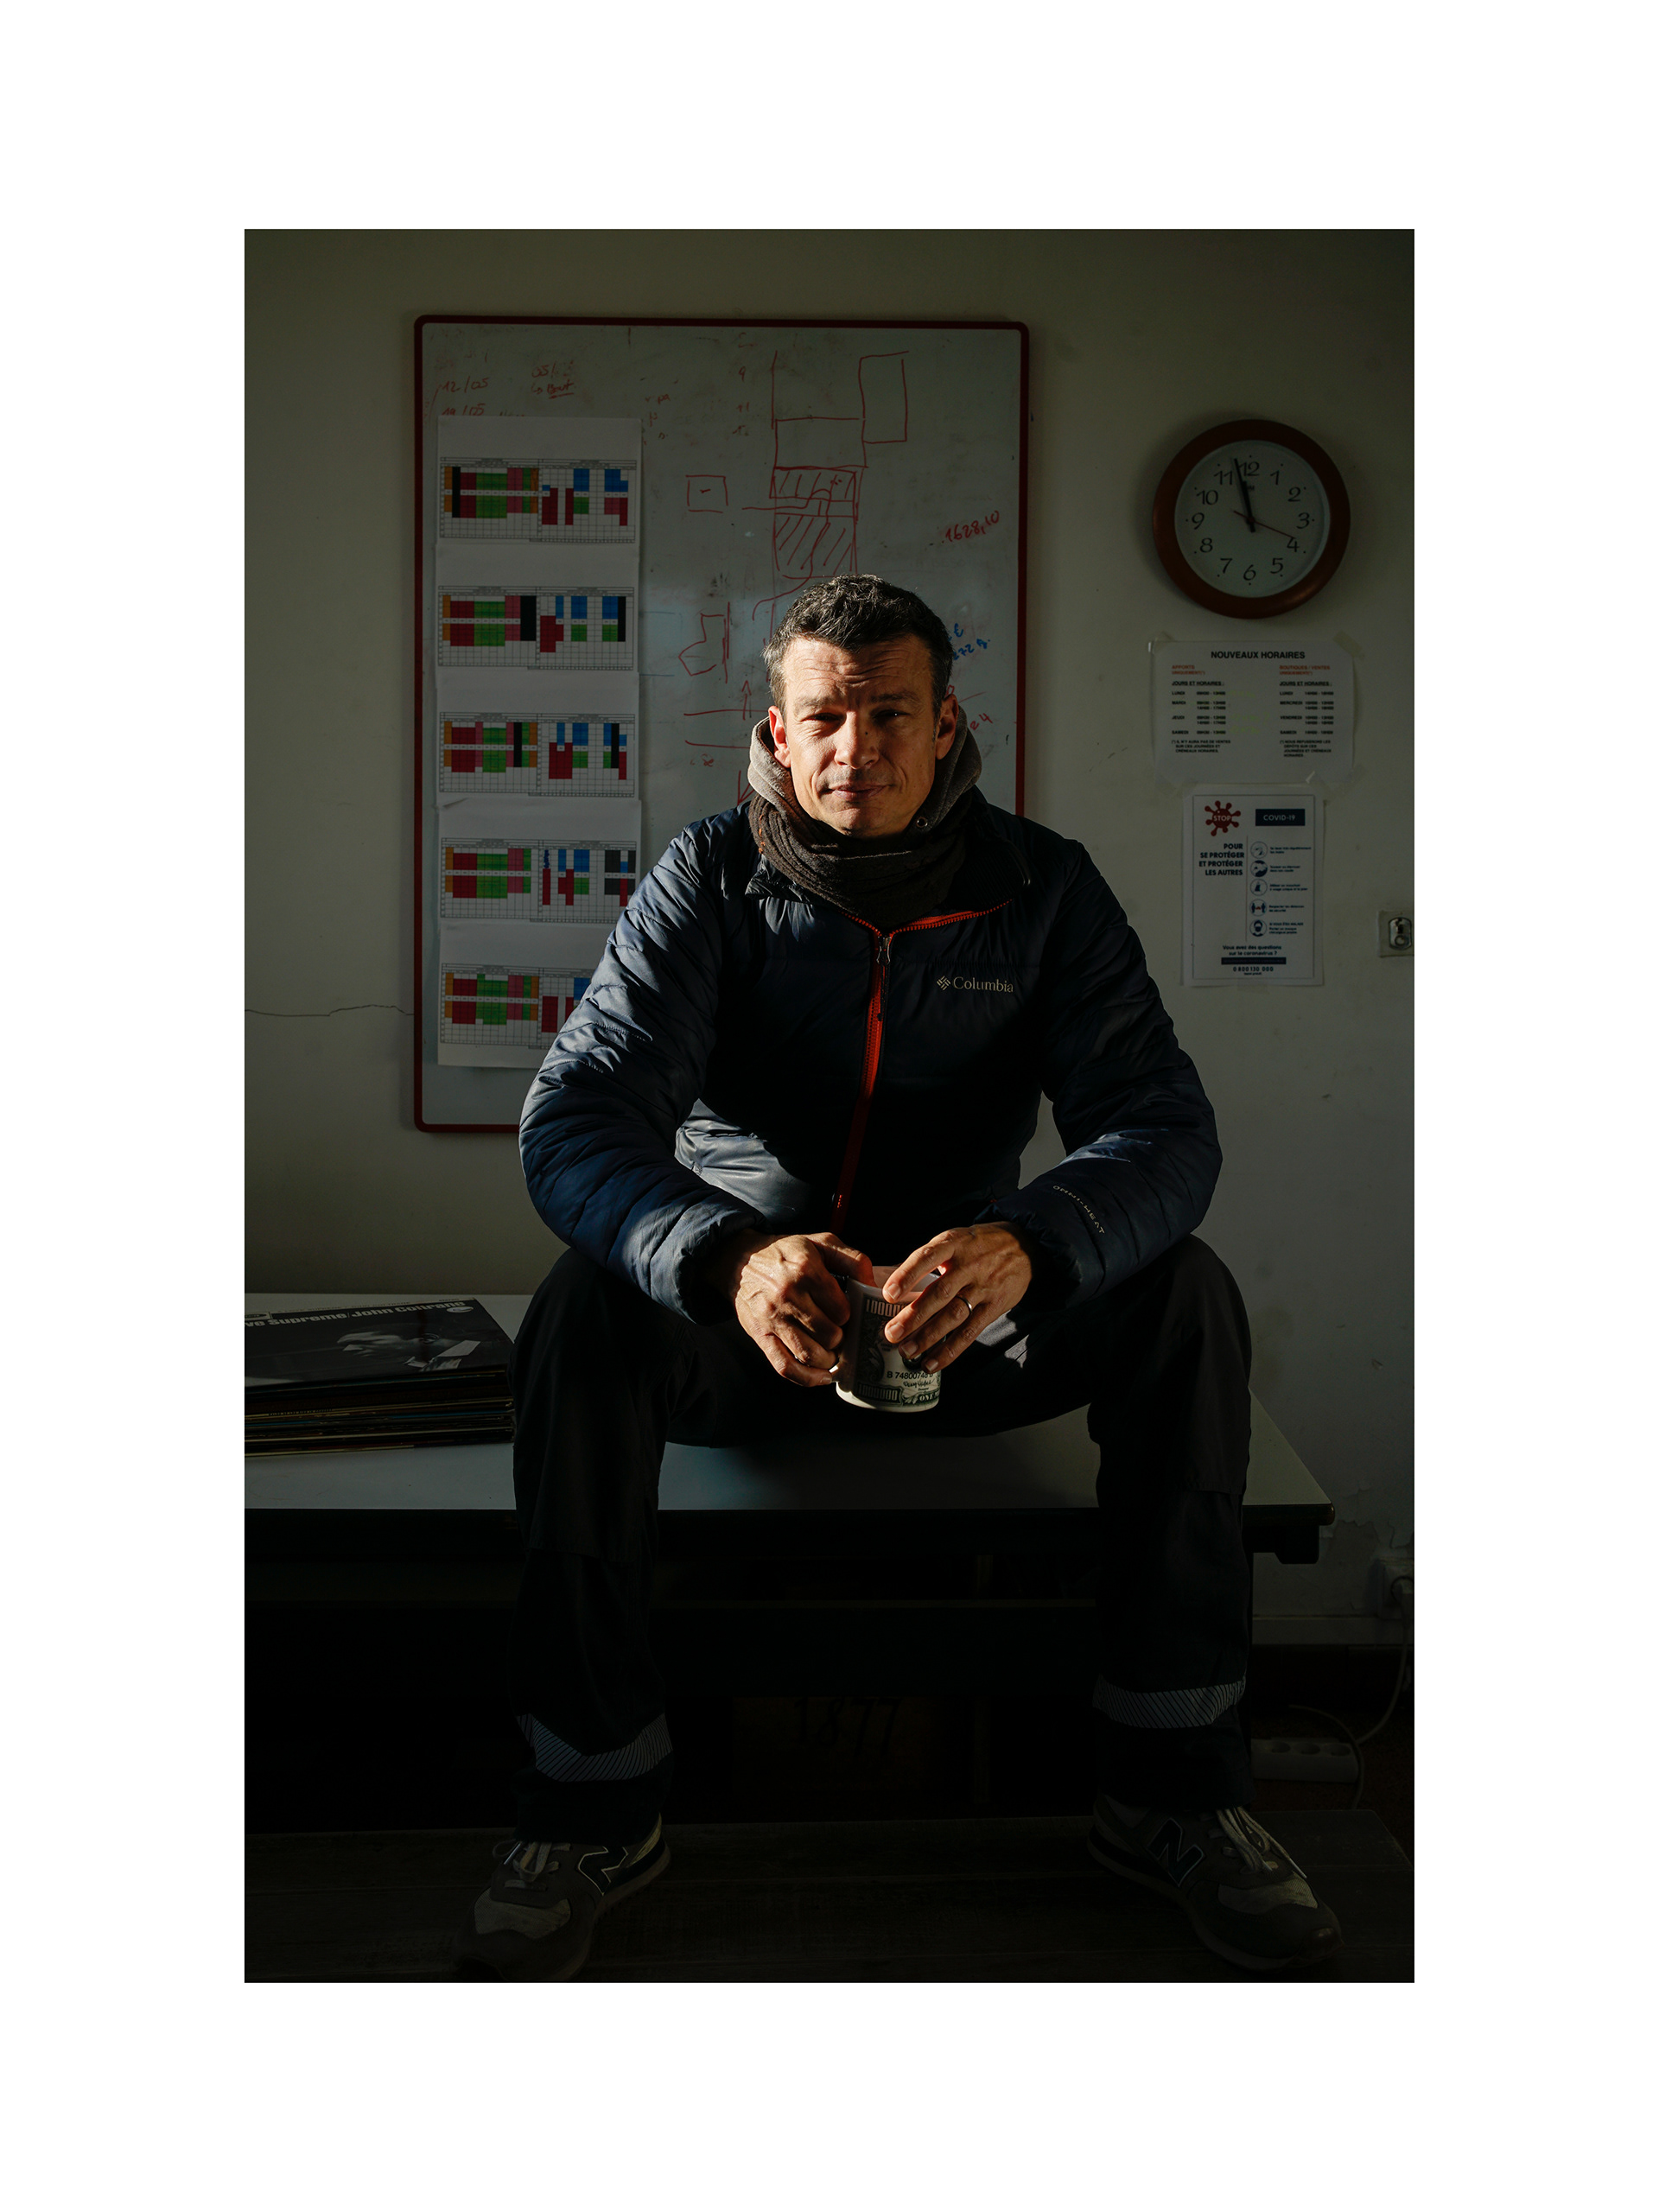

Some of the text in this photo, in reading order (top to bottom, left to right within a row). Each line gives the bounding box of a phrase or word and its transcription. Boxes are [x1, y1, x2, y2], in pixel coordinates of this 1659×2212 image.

[1238, 461, 1260, 476] 12
[1214, 470, 1233, 485] 11
[1270, 470, 1280, 485] 1
[1196, 490, 1218, 505] 10
[1287, 486, 1301, 502] 2
[1192, 512, 1205, 530] 9
[1296, 512, 1310, 529] 3
[1199, 537, 1213, 553] 8
[1287, 537, 1300, 552] 4
[1220, 558, 1233, 574] 7
[1243, 564, 1256, 581] 6
[1270, 557, 1284, 574] 5
[1211, 651, 1306, 659] NOUVEAUX HORAIRES
[952, 976, 1014, 994] Columbia
[1052, 1185, 1105, 1235] OMNI-HEAT
[394, 1301, 466, 1313] Coltrane
